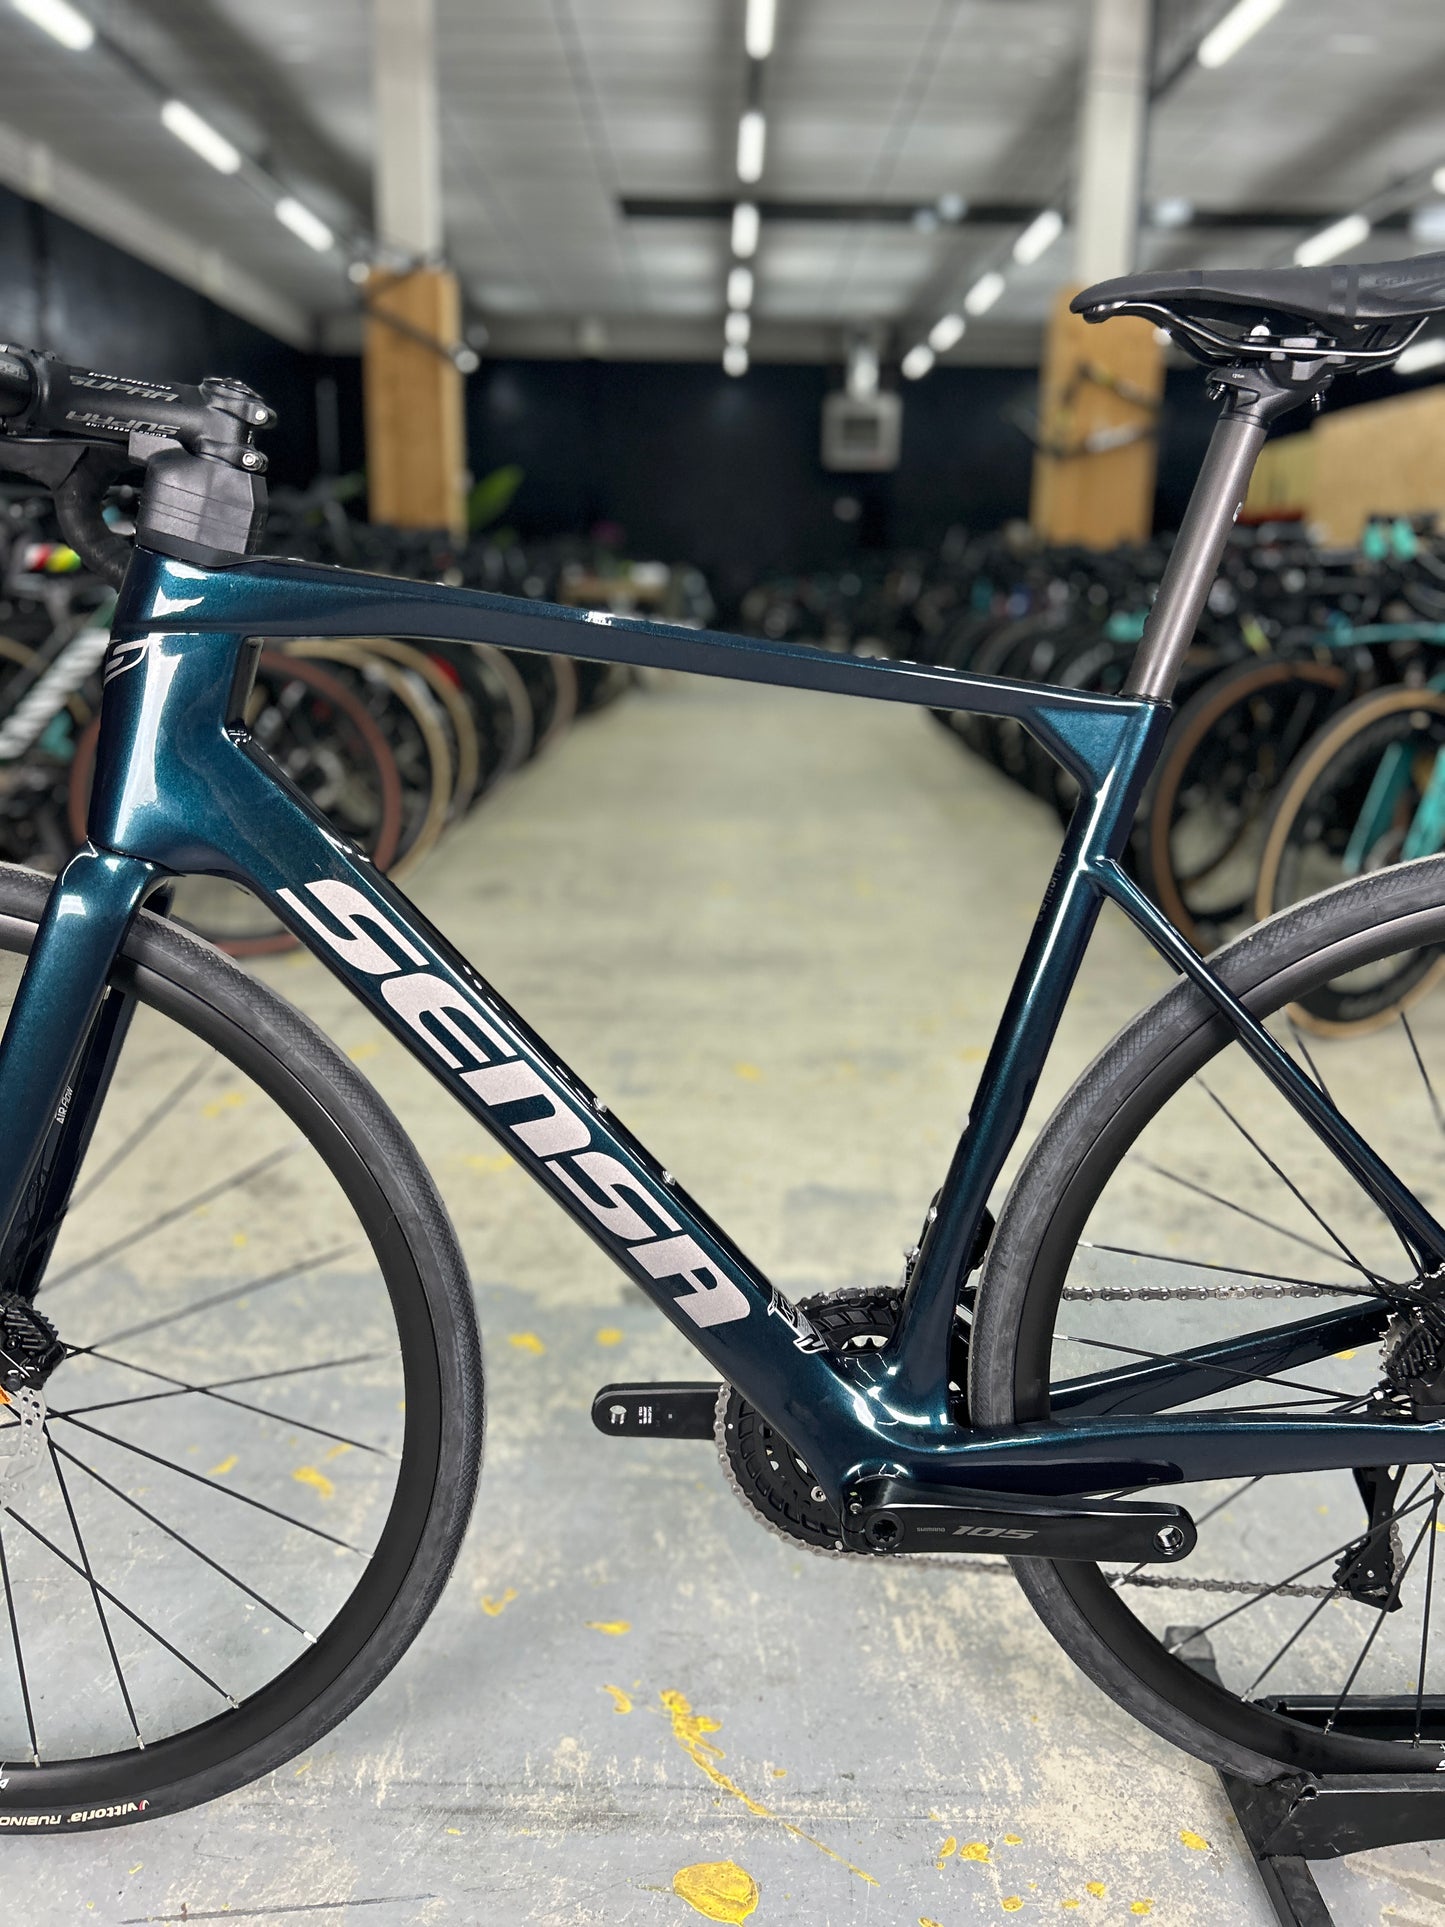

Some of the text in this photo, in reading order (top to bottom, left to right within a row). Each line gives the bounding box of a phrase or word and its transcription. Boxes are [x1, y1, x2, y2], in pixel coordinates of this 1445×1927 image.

[70, 375, 179, 402] SUPRA
[65, 411, 180, 435] SUPRA
[275, 878, 751, 1329] SENSA
[56, 1106, 67, 1124] AIR
[951, 1525, 1039, 1540] 105
[0, 1814, 62, 1827] RUBINO
